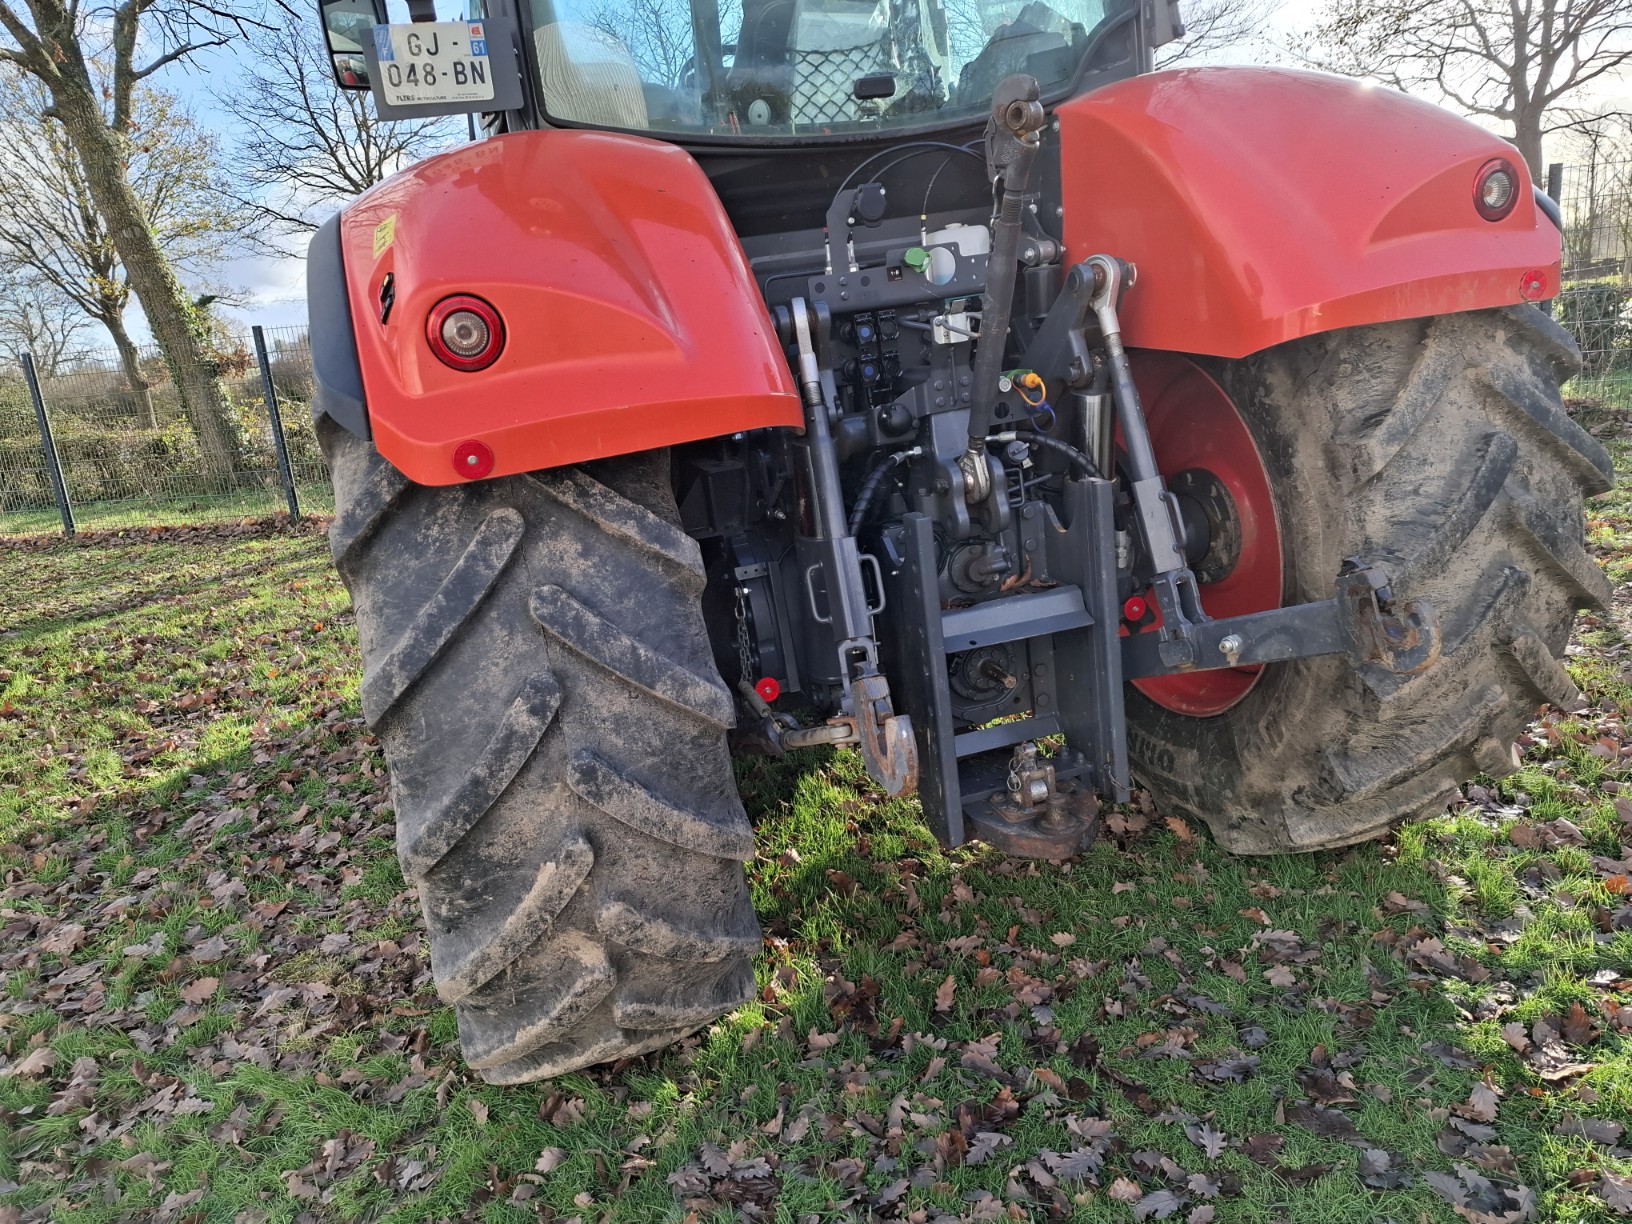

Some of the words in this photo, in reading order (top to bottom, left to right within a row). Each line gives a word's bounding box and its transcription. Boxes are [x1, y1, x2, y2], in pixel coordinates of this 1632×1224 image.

[407, 32, 439, 56] GJ
[472, 41, 486, 55] 61
[387, 61, 486, 87] 048-BN
